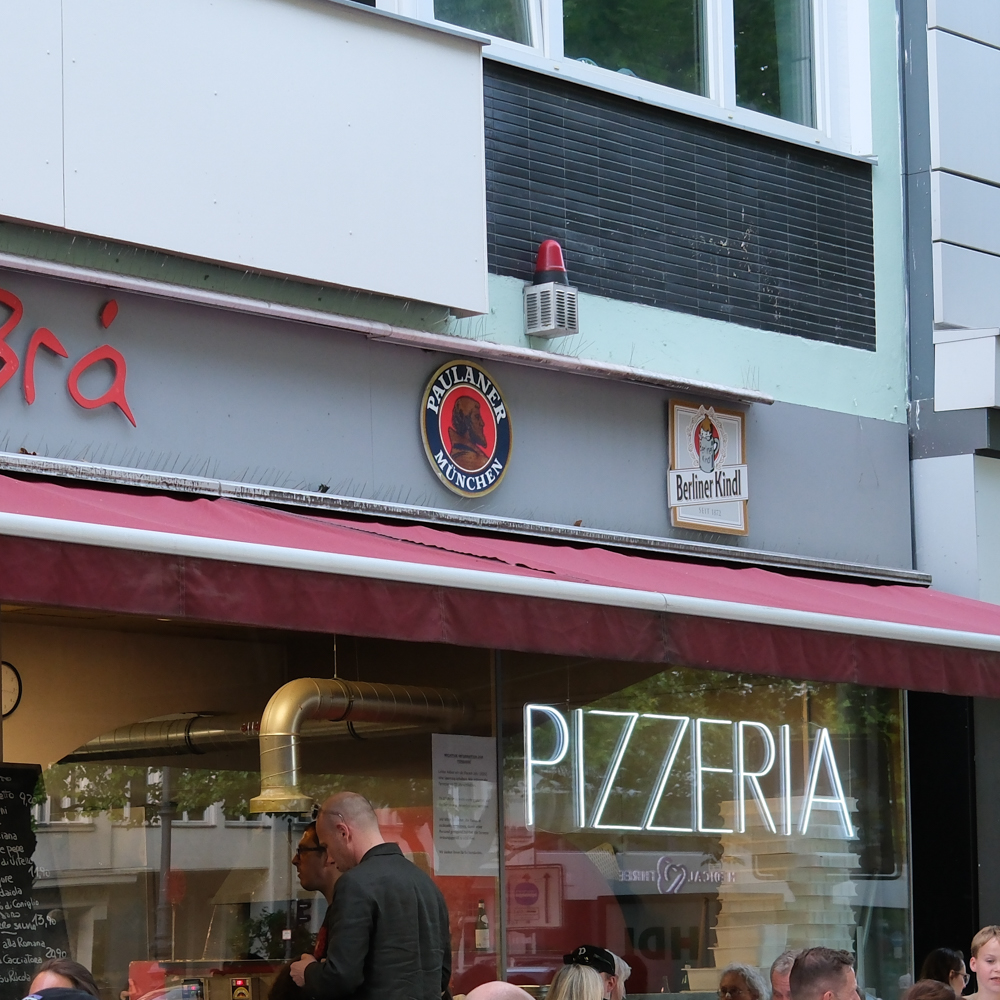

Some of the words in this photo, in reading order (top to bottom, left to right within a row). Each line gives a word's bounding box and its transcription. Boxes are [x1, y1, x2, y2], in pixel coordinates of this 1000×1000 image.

[426, 364, 507, 425] PAULANER
[434, 449, 504, 492] MÜNCHEN
[676, 473, 714, 501] Berliner
[714, 469, 741, 498] Kindl
[523, 703, 854, 838] PIZZERIA
